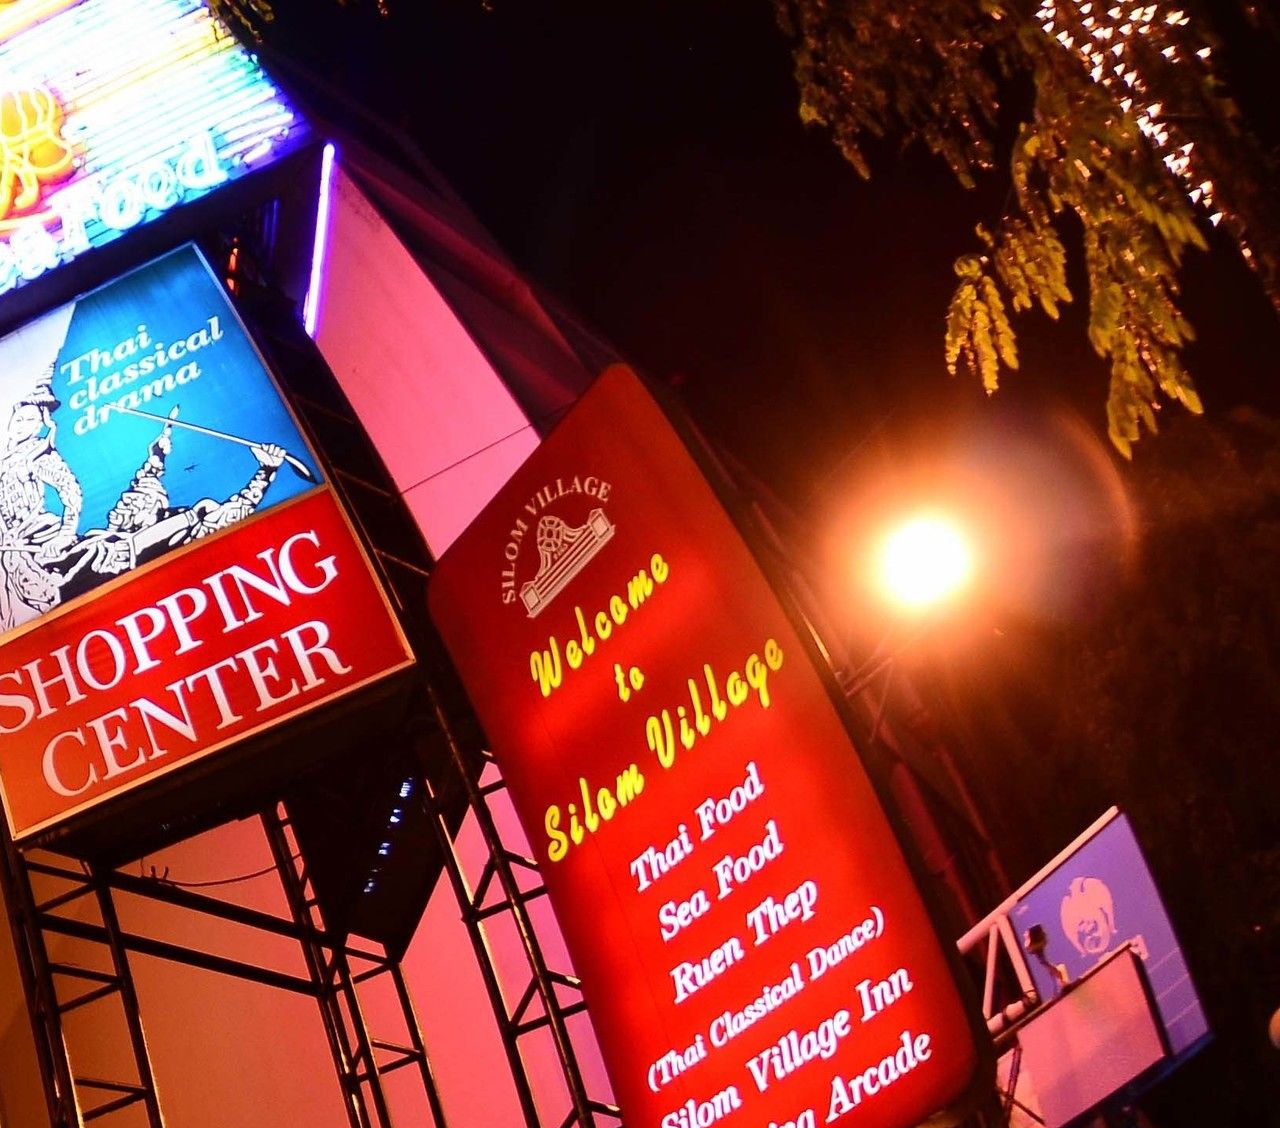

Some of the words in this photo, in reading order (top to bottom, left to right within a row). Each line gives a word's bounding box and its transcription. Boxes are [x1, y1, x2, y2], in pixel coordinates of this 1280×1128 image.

[60, 324, 152, 386] Thai
[69, 315, 224, 410] classical
[73, 360, 202, 436] drama
[501, 518, 529, 604] SILOM
[524, 475, 612, 516] VILLAGE
[529, 552, 669, 698] Welcome
[615, 663, 645, 702] to
[41, 619, 353, 797] CENTER
[544, 762, 646, 862] Silom
[645, 638, 785, 769] Village
[629, 824, 694, 892] Thai
[694, 761, 765, 842] Food
[657, 887, 711, 943] Sea
[711, 820, 785, 901] Food
[647, 1034, 707, 1093] (Thai
[708, 965, 805, 1049] Classical
[806, 905, 886, 984] Dance)
[669, 934, 745, 1004] Ruen
[746, 879, 819, 949] Thep
[745, 1010, 852, 1093] Village
[857, 965, 914, 1025] Inn
[825, 1030, 933, 1125] Arcade
